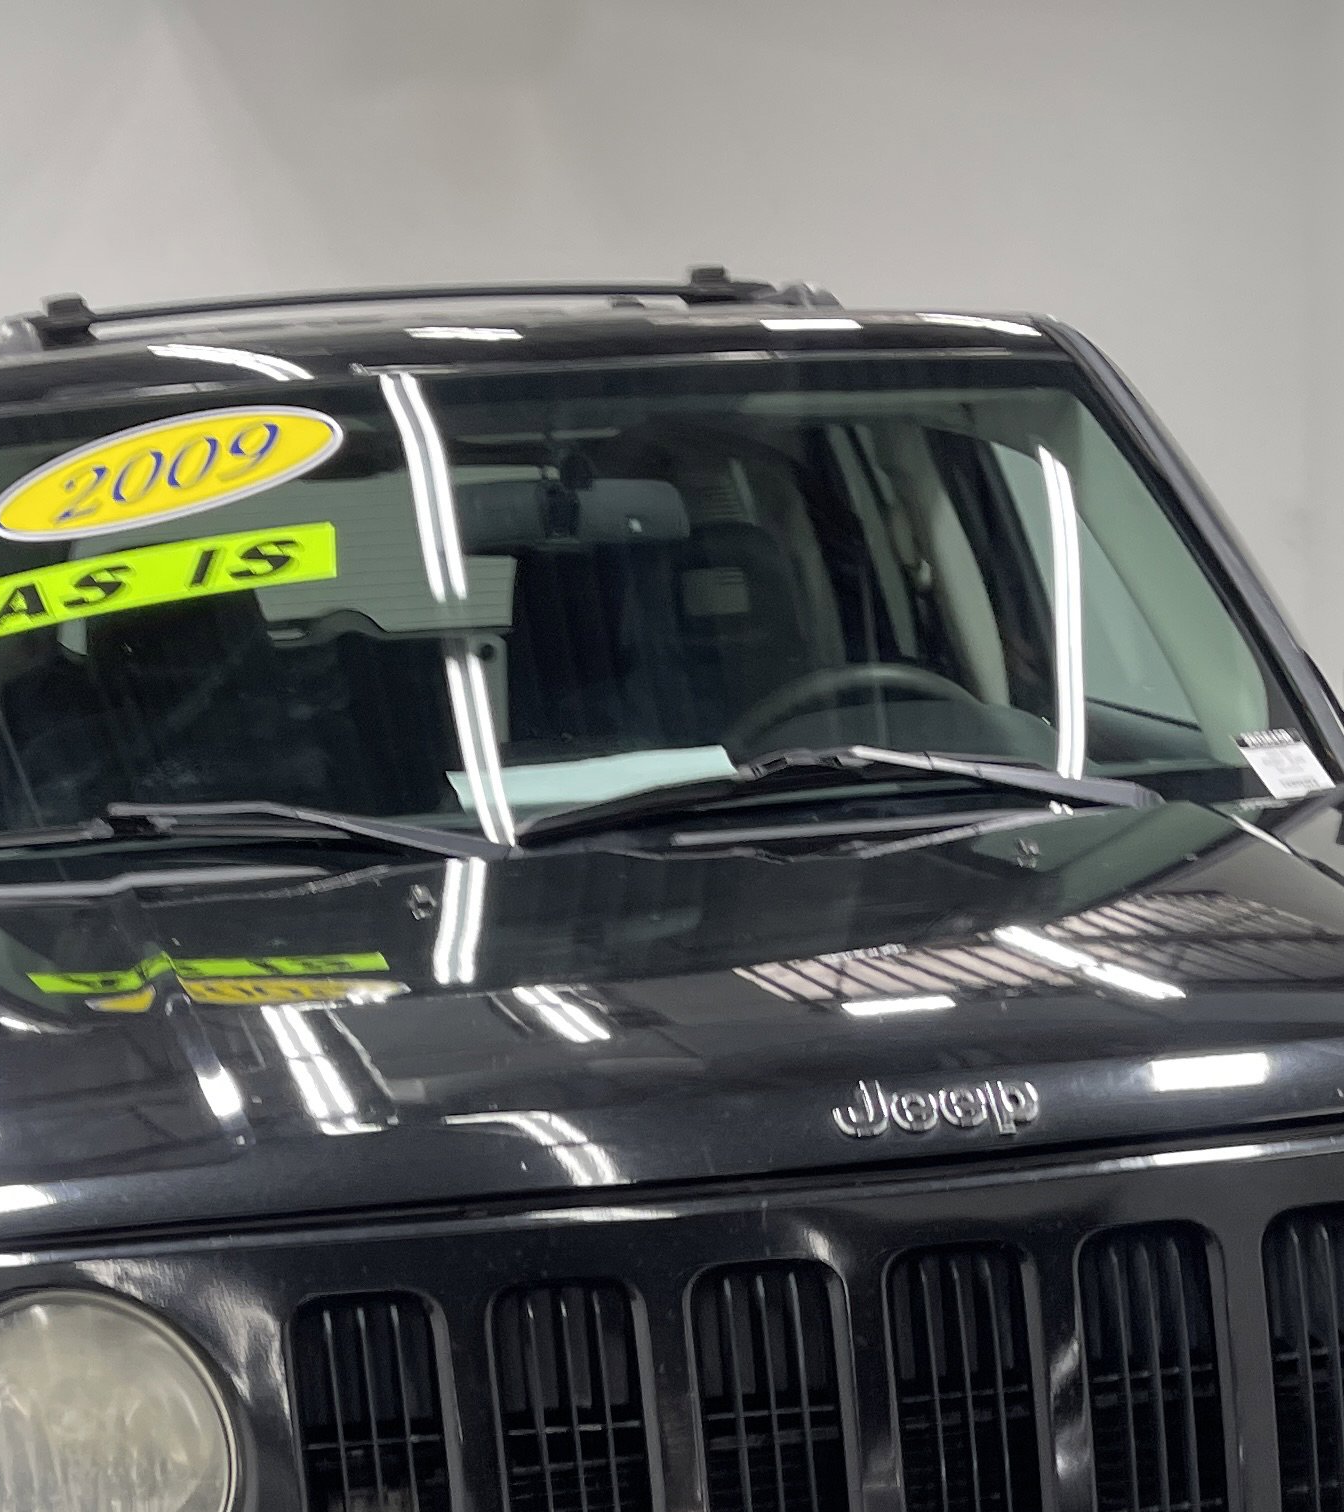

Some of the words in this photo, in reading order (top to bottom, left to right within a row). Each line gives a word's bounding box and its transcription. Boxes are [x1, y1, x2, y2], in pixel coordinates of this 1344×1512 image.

[57, 422, 279, 522] 2009
[187, 539, 300, 588] IS
[832, 1079, 1039, 1137] Jeep
